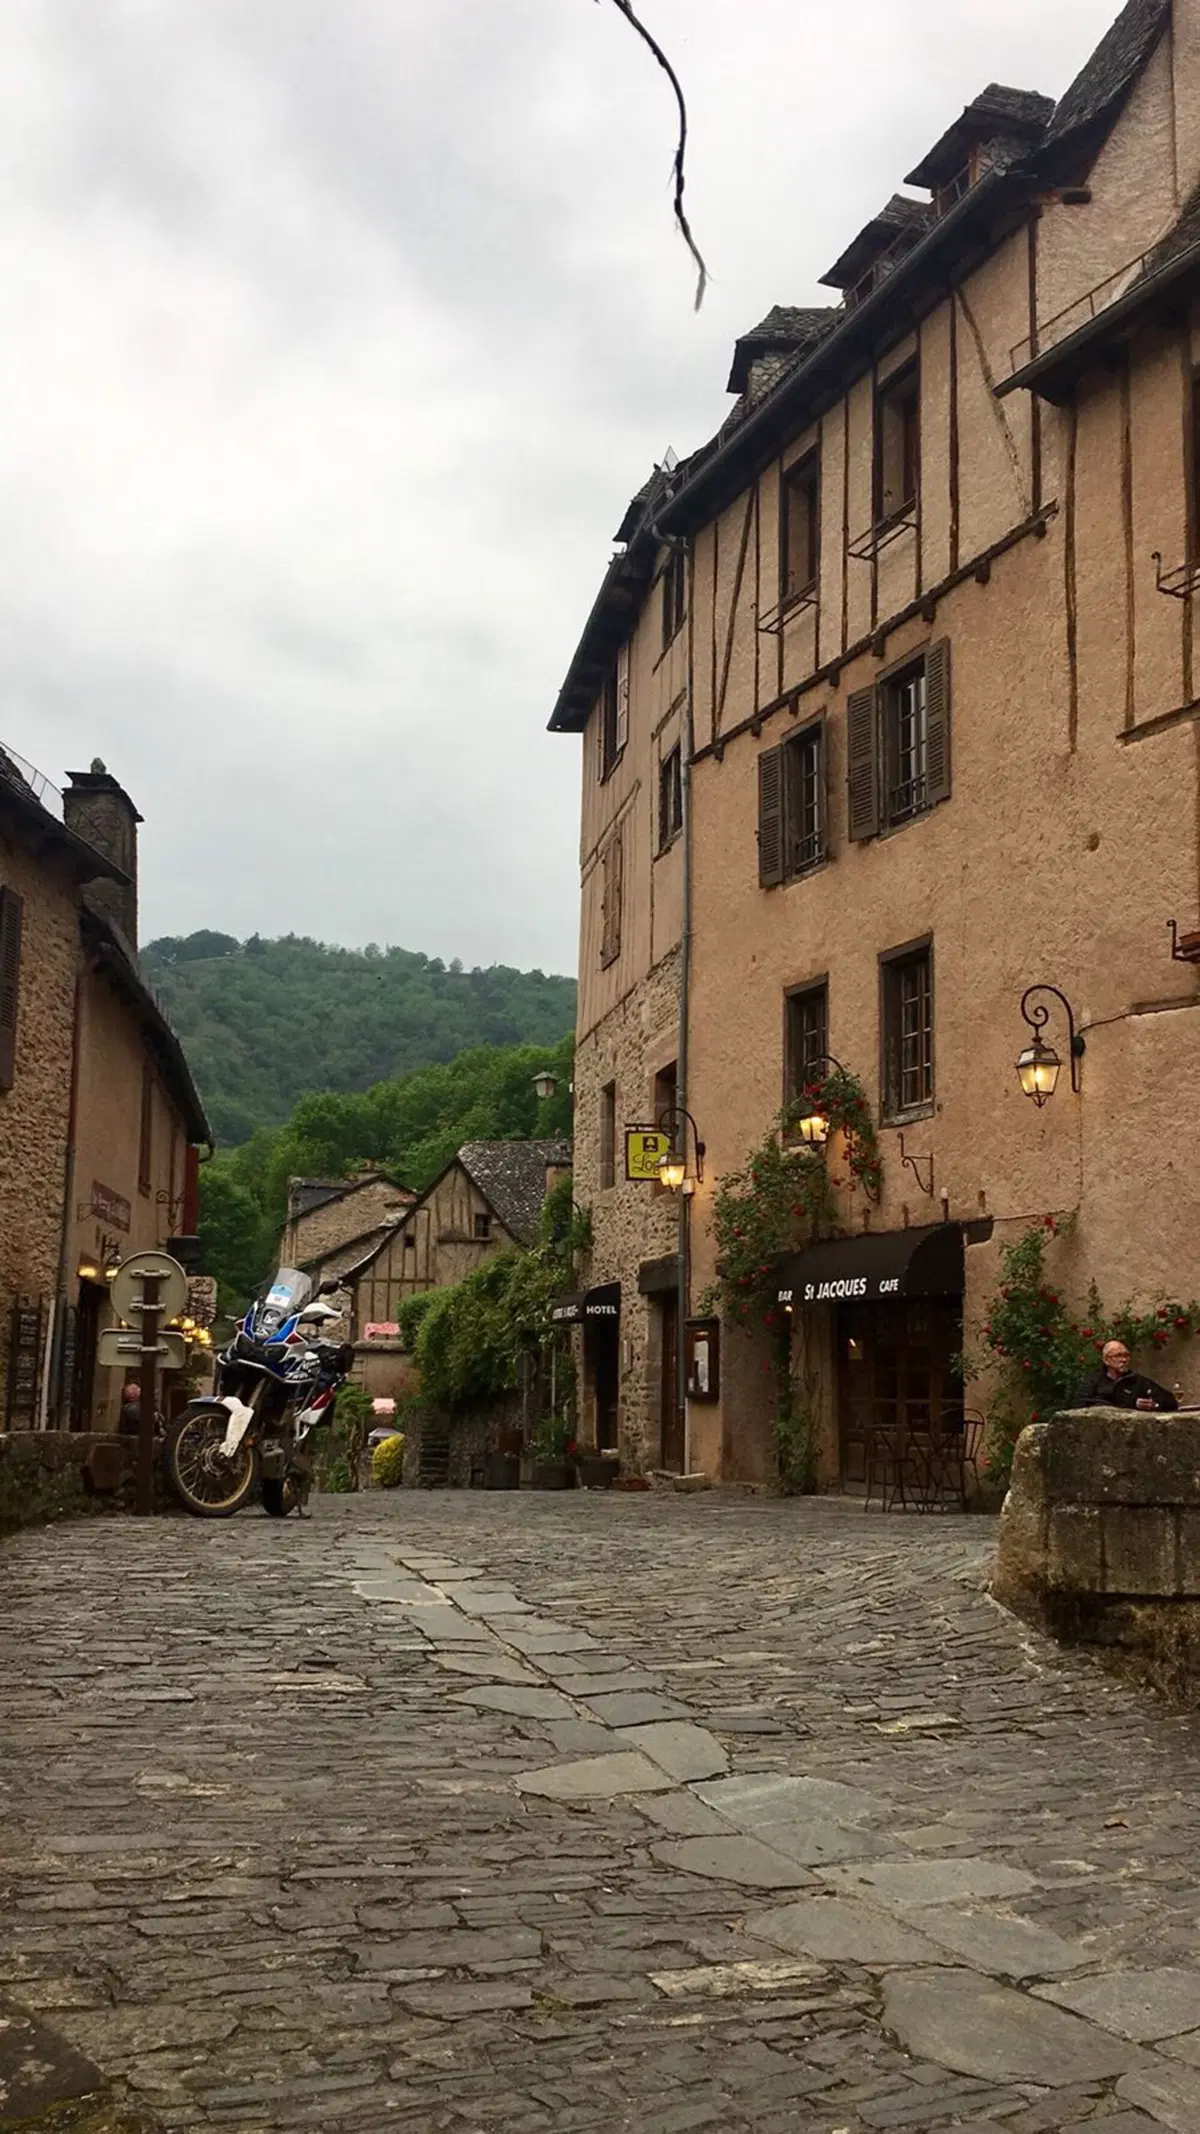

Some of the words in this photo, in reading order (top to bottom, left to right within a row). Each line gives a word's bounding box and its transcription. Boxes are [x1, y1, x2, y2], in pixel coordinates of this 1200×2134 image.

[778, 1290, 793, 1302] BAR
[816, 1277, 868, 1300] JACQUES
[879, 1278, 900, 1293] CAFE
[586, 1304, 618, 1315] HOTEL
